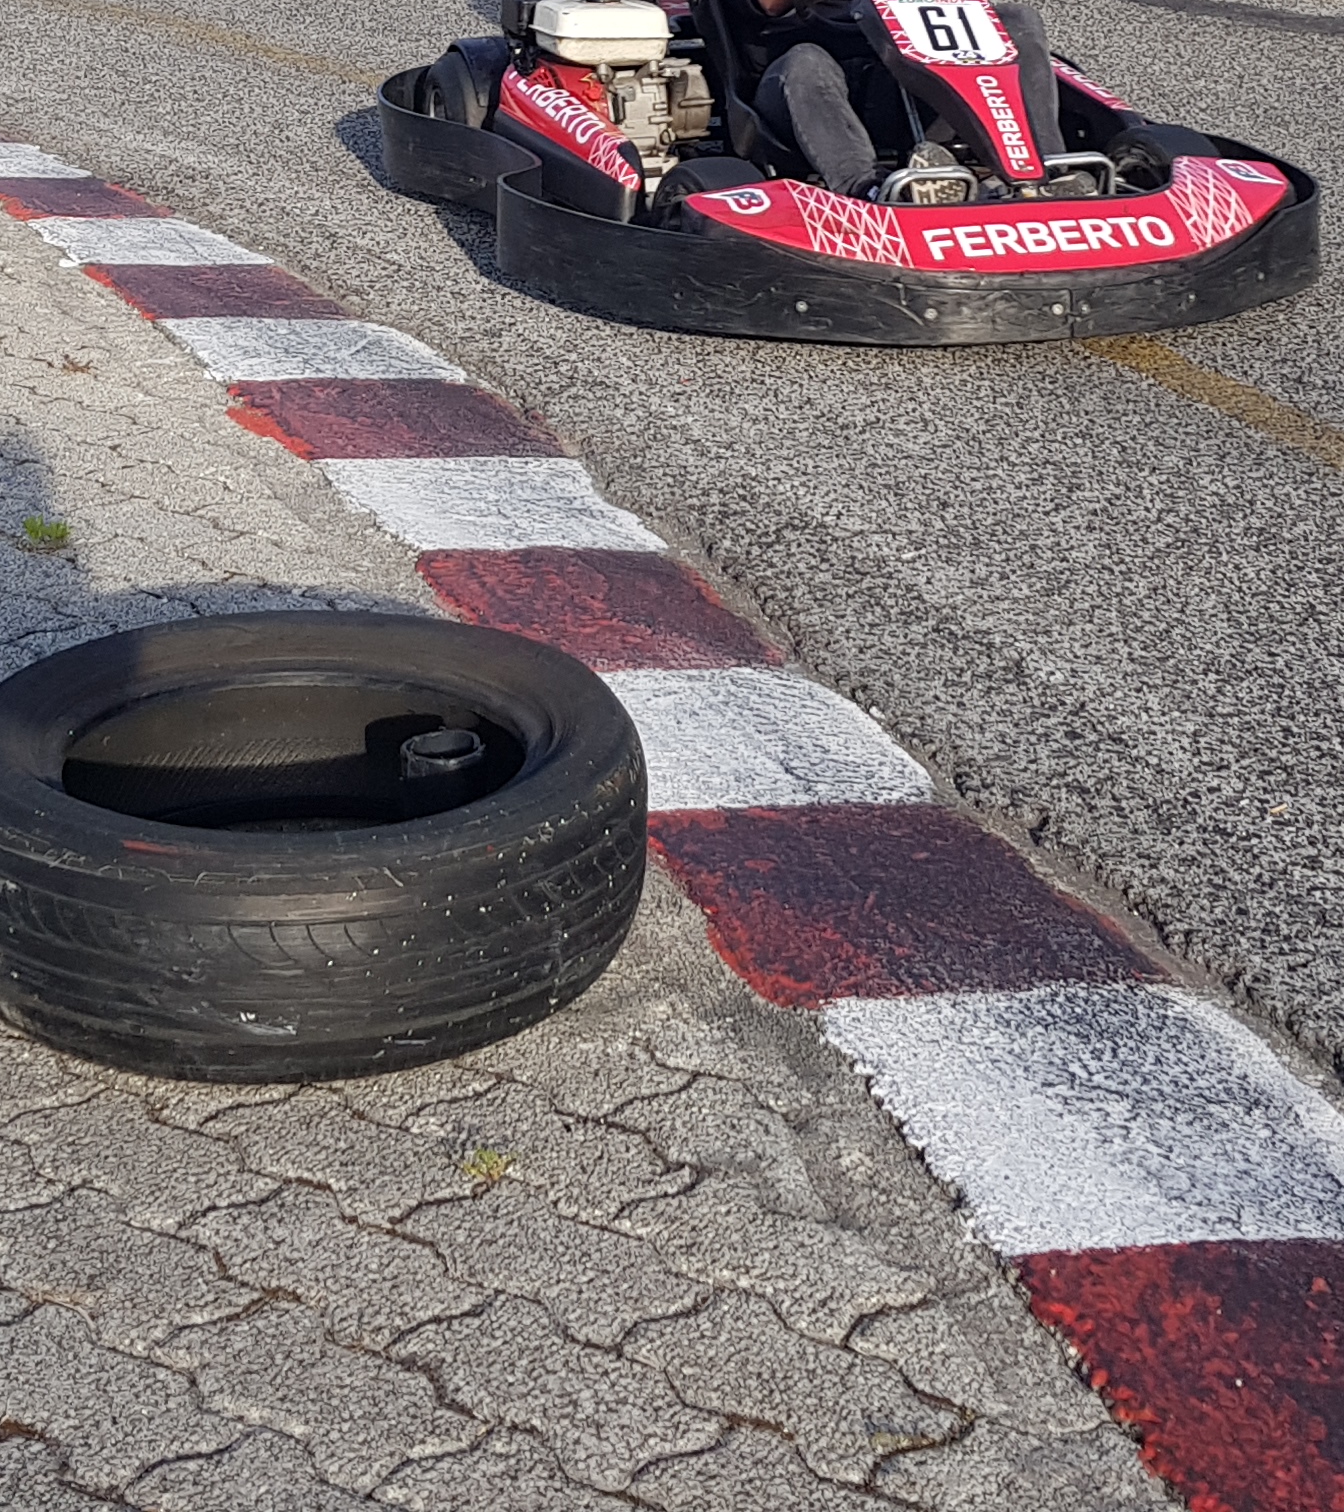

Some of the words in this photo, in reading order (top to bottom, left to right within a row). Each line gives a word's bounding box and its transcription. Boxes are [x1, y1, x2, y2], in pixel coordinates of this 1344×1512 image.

[917, 6, 981, 51] 61
[975, 75, 1035, 173] FERBERTO
[922, 215, 1175, 261] FERBERTO
